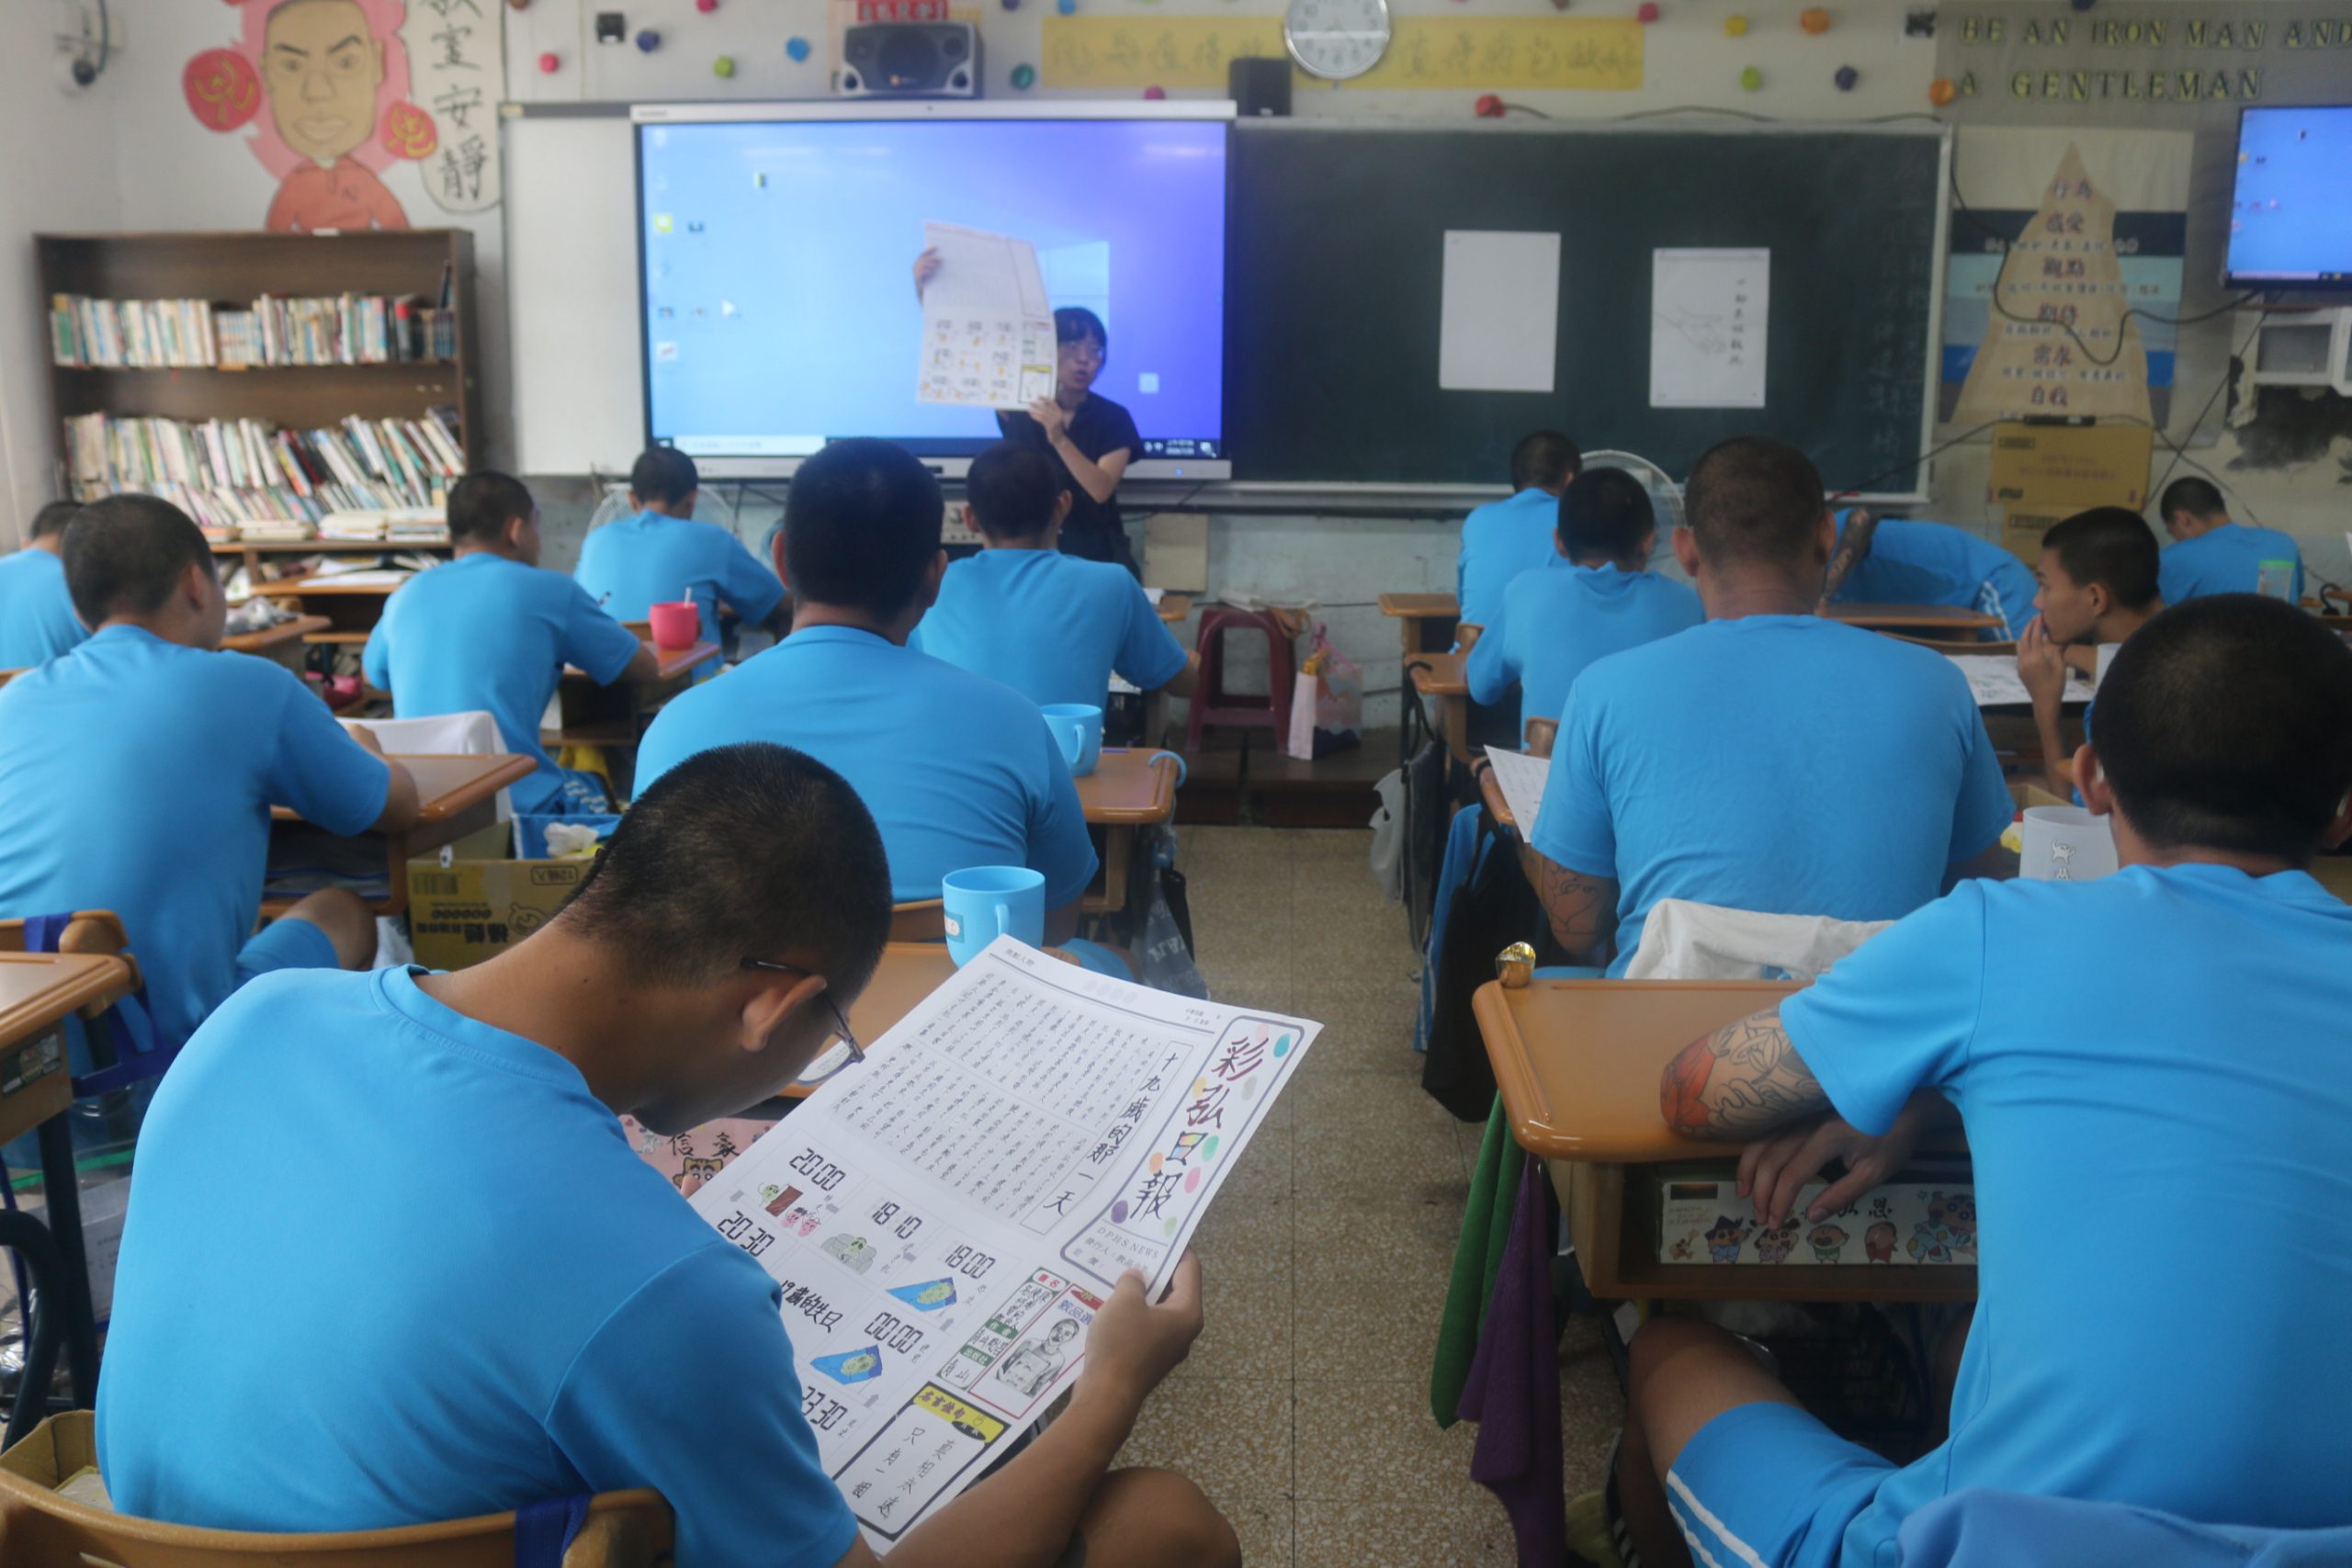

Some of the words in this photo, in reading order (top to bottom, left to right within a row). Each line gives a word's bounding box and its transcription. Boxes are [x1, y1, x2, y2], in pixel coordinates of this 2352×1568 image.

[1961, 17, 2005, 44] BE
[2024, 18, 2068, 45] AN
[2089, 19, 2165, 46] IRON
[2185, 19, 2267, 48] MAN
[2284, 19, 2352, 49] AND
[1961, 70, 1977, 96] A
[2011, 68, 2262, 101] GENTLEMAN
[1044, 1052, 1178, 1216] 十九歲的那一天
[1130, 1036, 1270, 1222] 彩弘日報
[853, 1427, 925, 1499] 只有一個
[877, 1439, 956, 1518] 真相永遠
